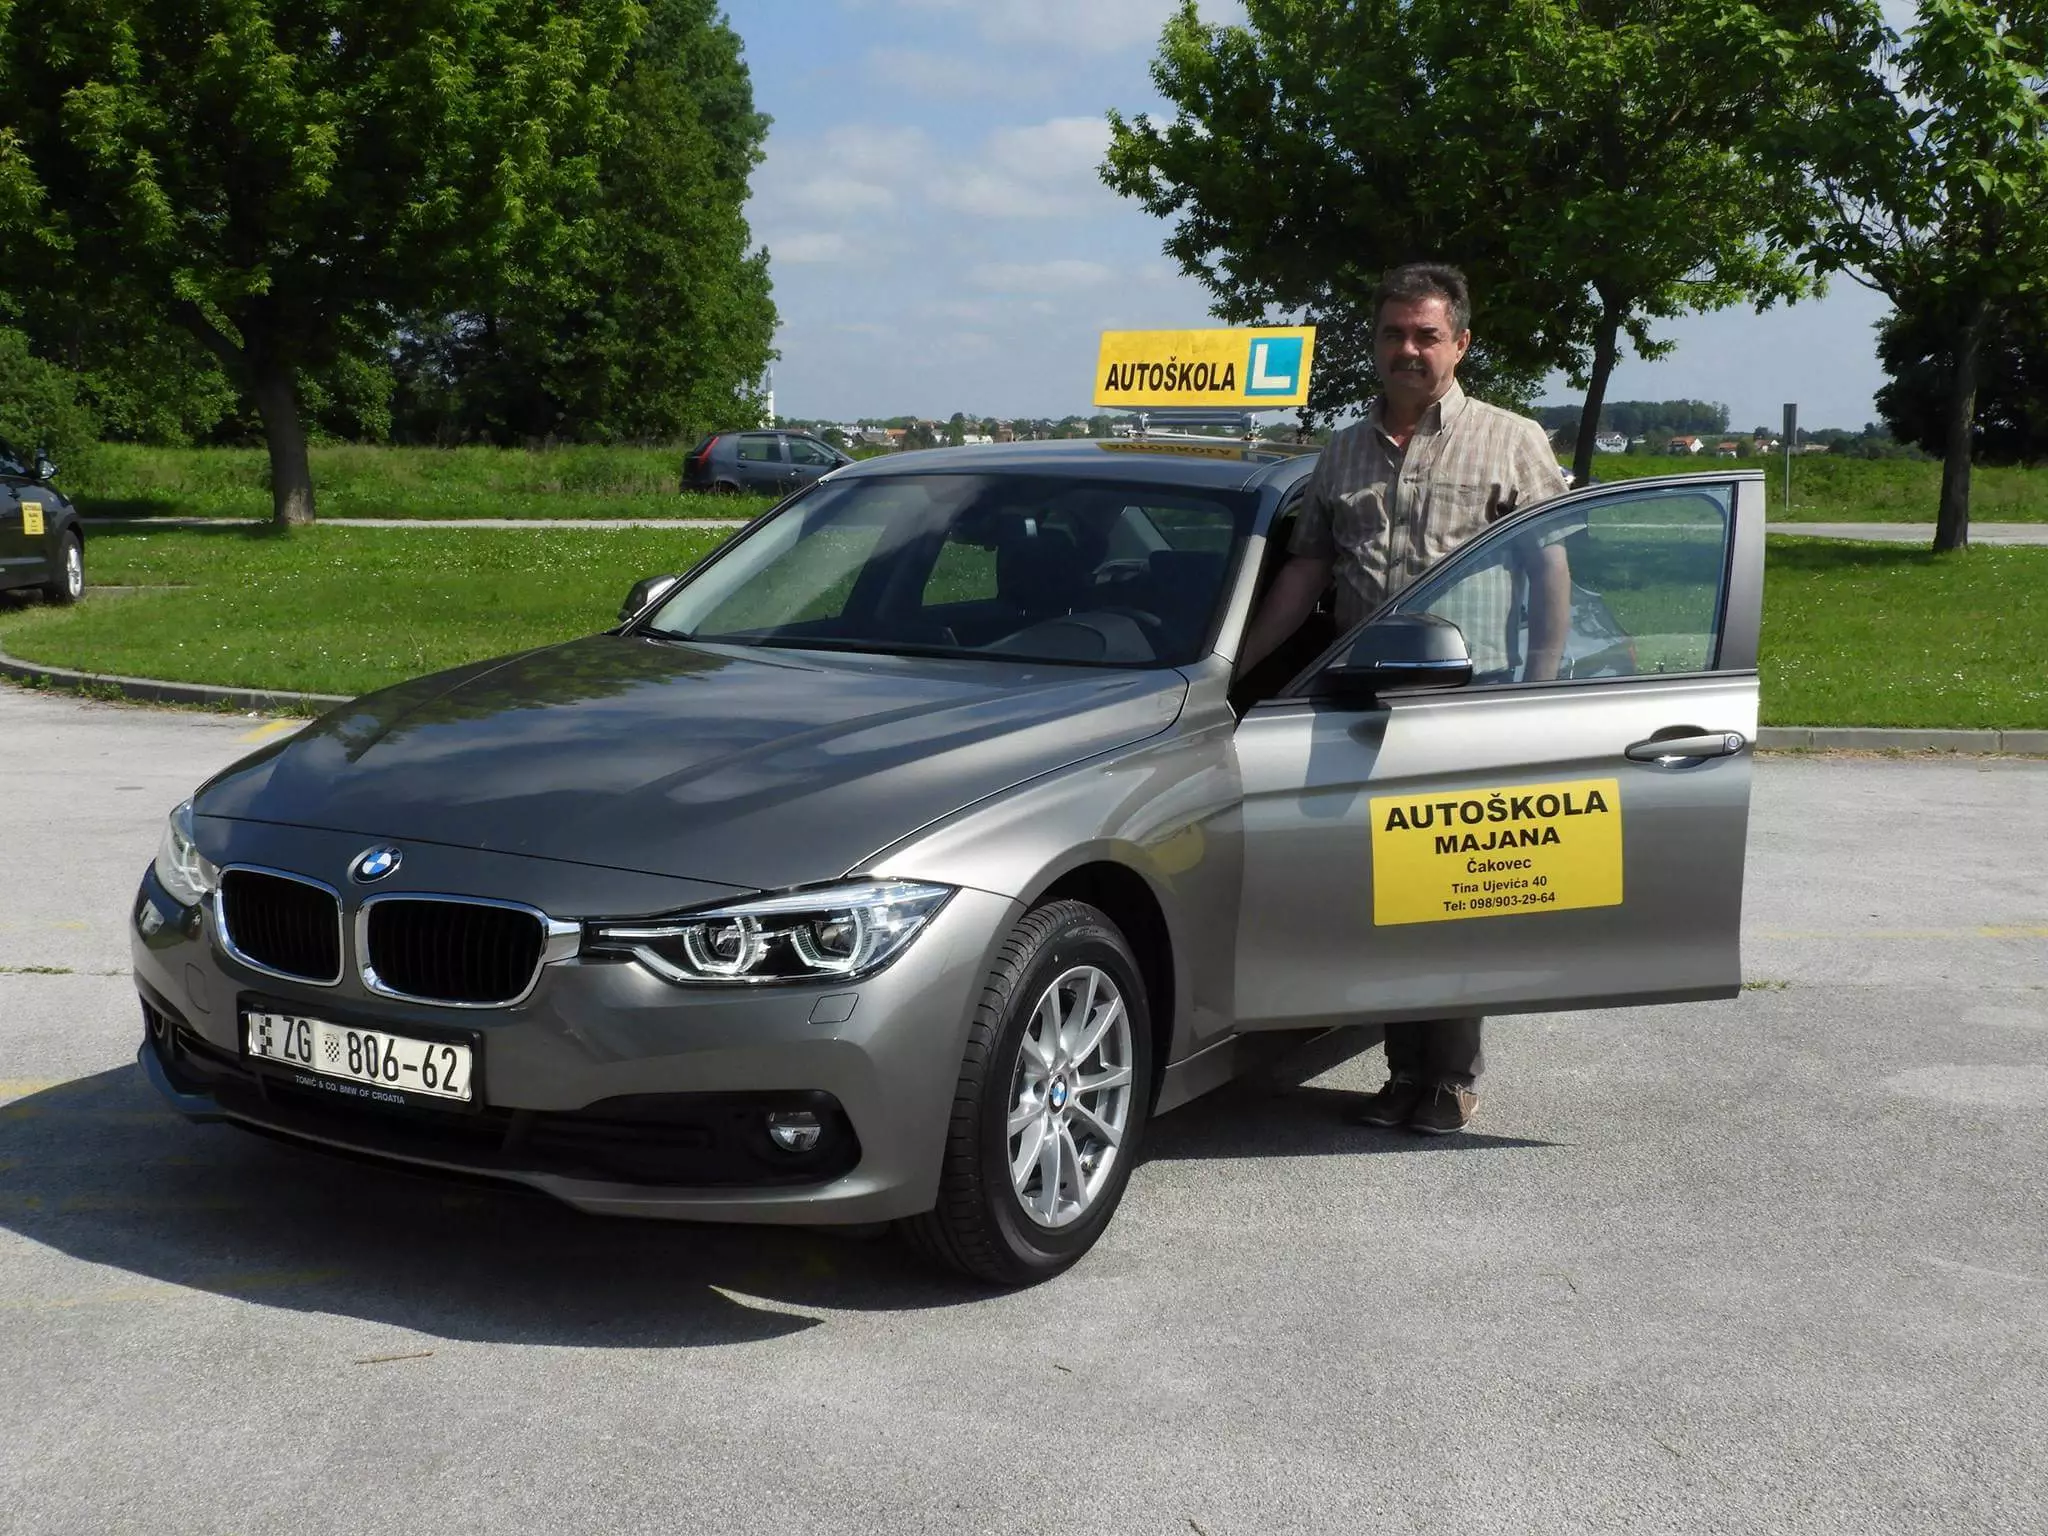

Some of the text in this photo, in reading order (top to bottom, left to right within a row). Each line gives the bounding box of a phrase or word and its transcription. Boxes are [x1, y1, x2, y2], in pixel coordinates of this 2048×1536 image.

[1105, 356, 1235, 391] AUTOŠKOLA
[1252, 344, 1291, 388] L
[1385, 790, 1608, 831] AUTOŠKOLA
[1435, 827, 1561, 854] MAJANA
[1467, 857, 1532, 873] Čakovec
[1452, 875, 1547, 894] Tina Ujevića 40
[1443, 892, 1556, 912] Tel: 098/903-29-64
[283, 1016, 458, 1093] ZG 806-62
[339, 1085, 357, 1096] BMW
[359, 1088, 370, 1097] OF
[371, 1090, 405, 1105] CROATIA
